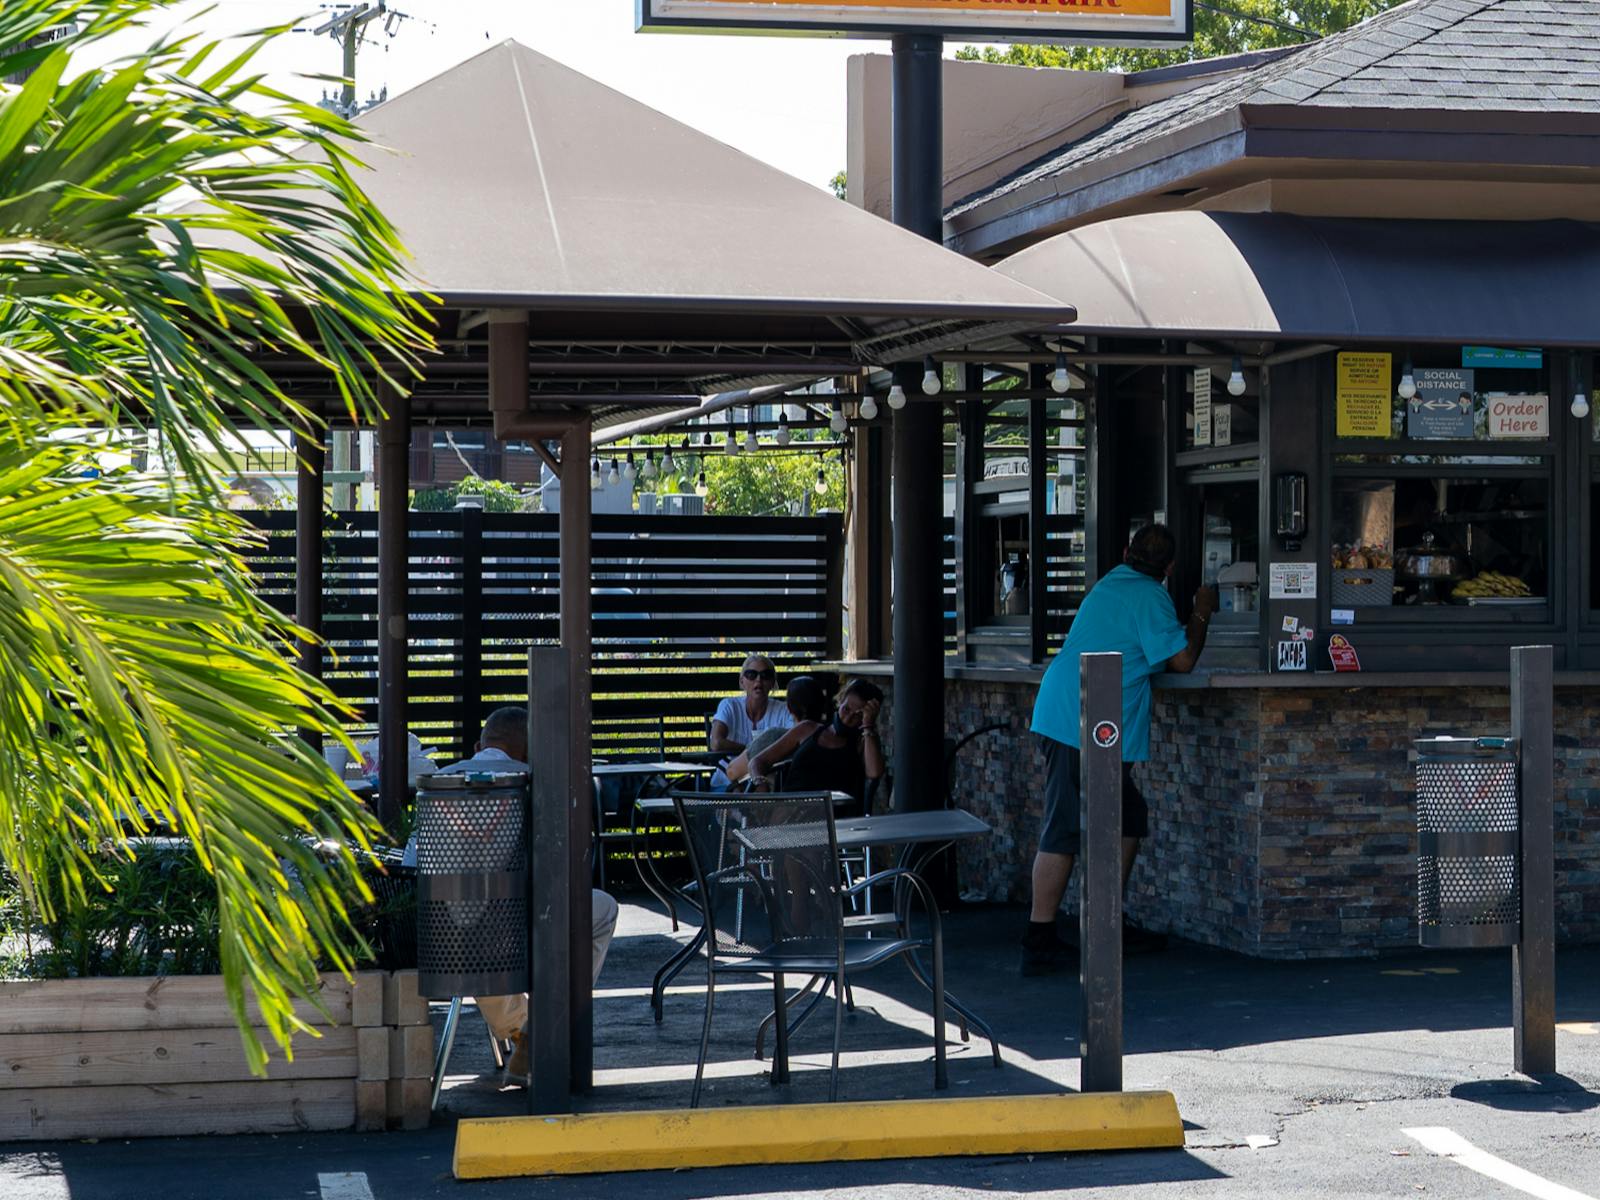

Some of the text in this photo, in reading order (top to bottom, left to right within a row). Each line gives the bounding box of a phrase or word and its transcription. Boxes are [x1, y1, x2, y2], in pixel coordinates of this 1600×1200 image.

[1424, 371, 1462, 380] SOCIAL
[1416, 380, 1467, 390] DISTANCE
[1493, 400, 1544, 417] Order
[1500, 418, 1538, 433] Here
